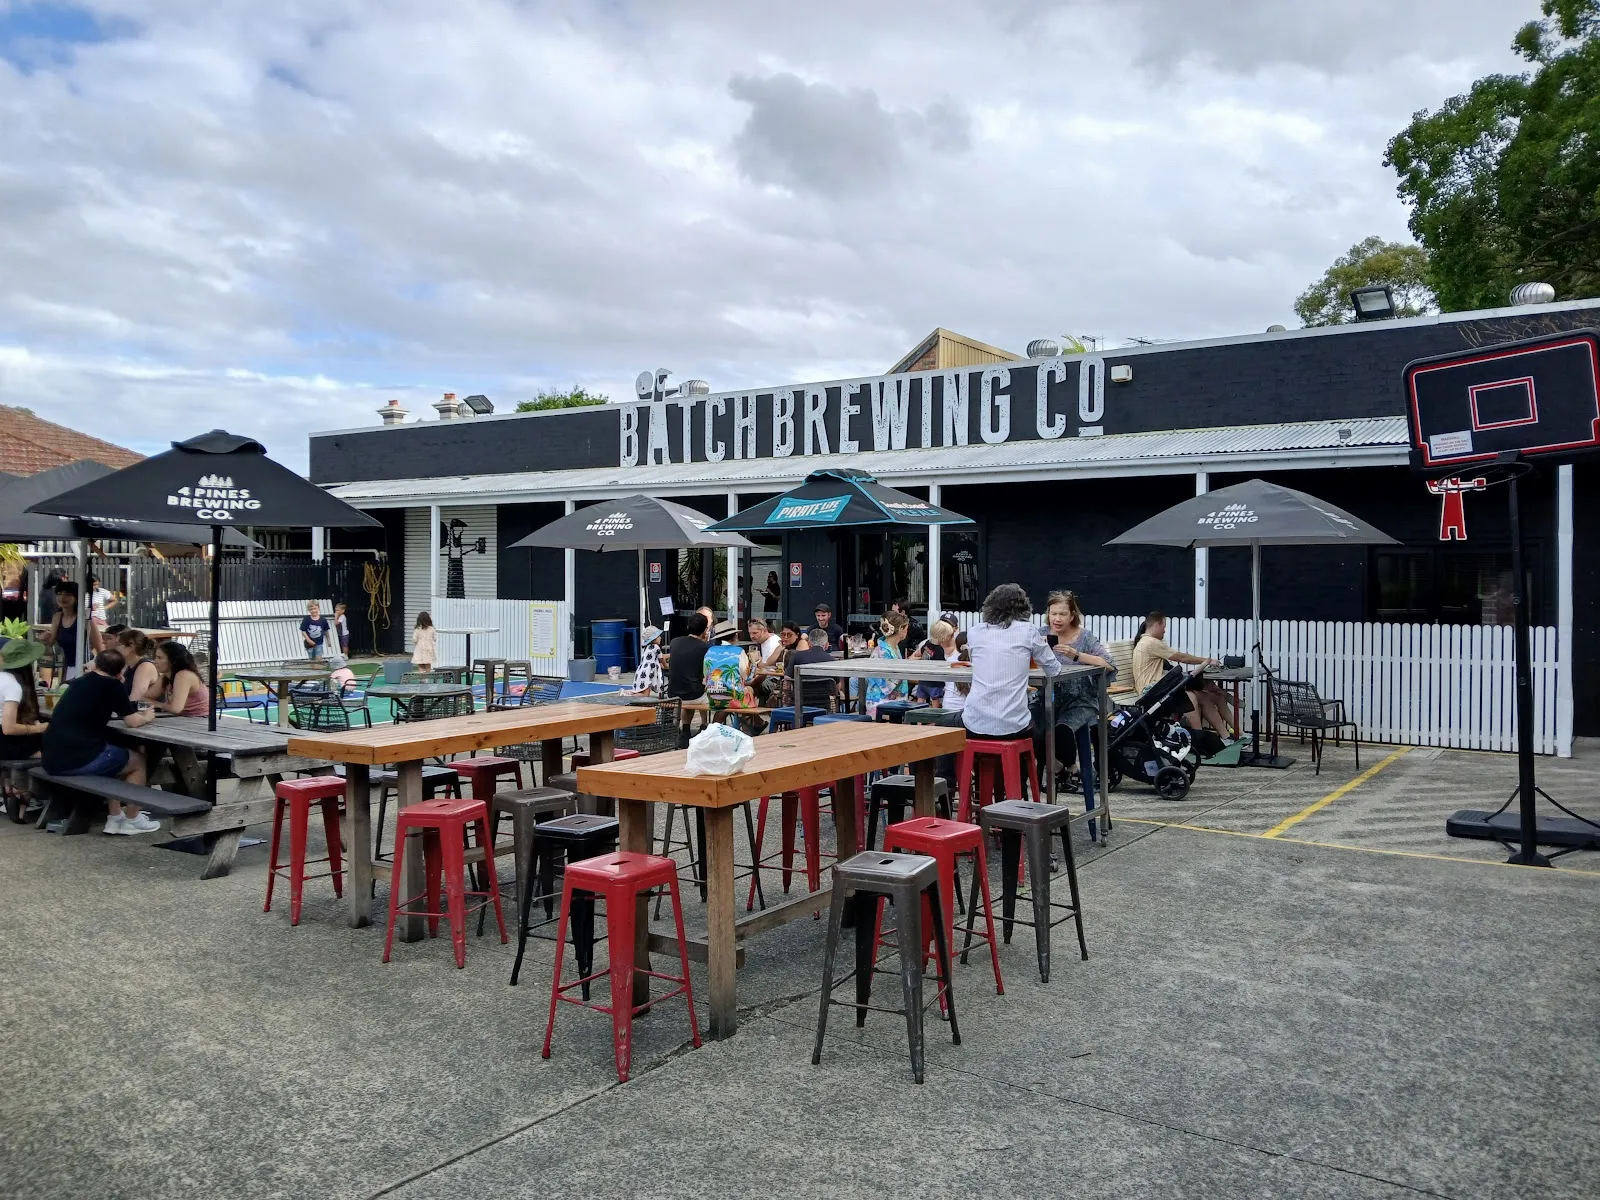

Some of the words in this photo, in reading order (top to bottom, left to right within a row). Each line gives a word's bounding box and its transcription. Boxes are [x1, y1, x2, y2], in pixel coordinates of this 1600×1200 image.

[620, 393, 756, 467] BATCH
[773, 365, 1011, 458] BREWING
[177, 486, 191, 496] 4
[194, 487, 250, 499] PINES
[166, 495, 261, 510] BREWING
[196, 508, 234, 520] CO.
[1197, 516, 1259, 524] BREWING
[585, 523, 634, 531] BREWING
